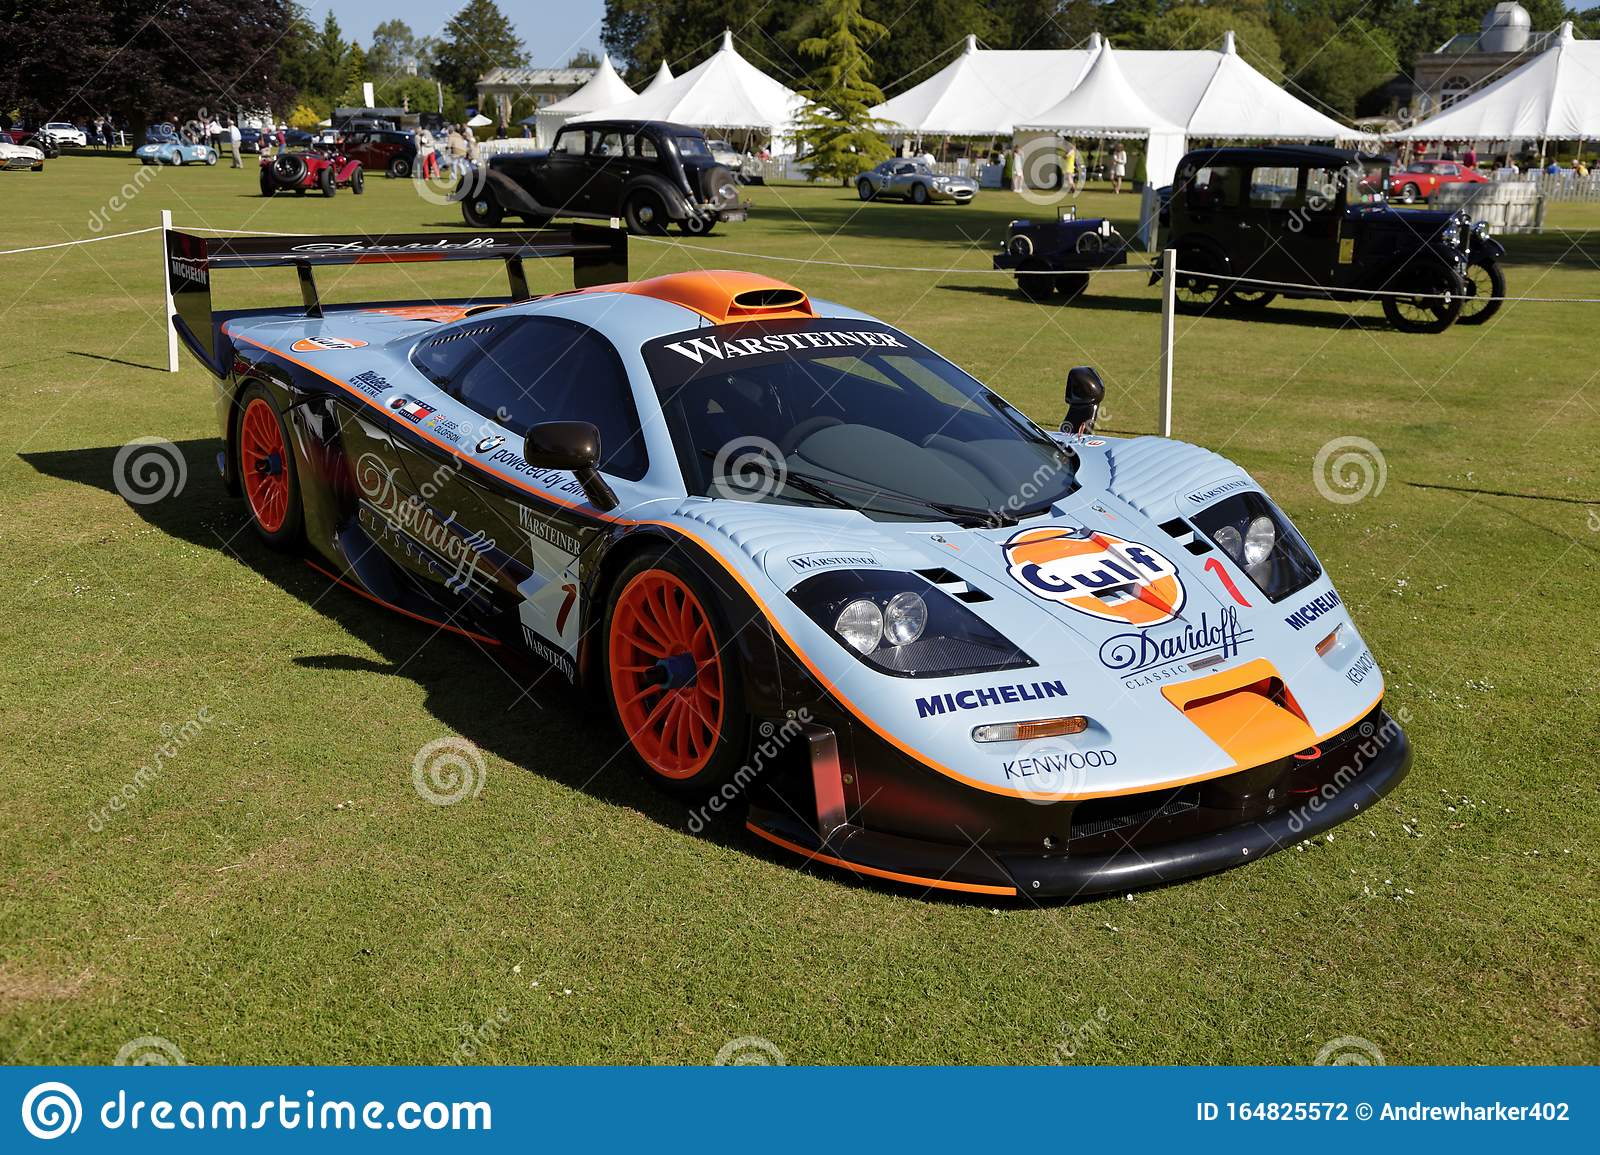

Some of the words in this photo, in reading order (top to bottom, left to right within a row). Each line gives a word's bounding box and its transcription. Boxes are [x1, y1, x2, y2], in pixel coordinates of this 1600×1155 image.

[172, 260, 207, 285] MICHELIN
[663, 331, 908, 365] WARSTEINER
[349, 377, 380, 399] MAGAZINE
[488, 449, 554, 479] powered
[542, 470, 567, 489] by
[519, 503, 581, 556] WARSTEINER
[791, 556, 878, 569] WARSTEINER
[1020, 546, 1164, 593] Gulf
[1204, 557, 1253, 608] 1
[555, 583, 577, 638] 1
[1284, 589, 1342, 631] MICHELIN
[522, 624, 574, 686] WARSTEINER
[1098, 605, 1255, 676] Davidoff
[1125, 665, 1188, 690] CLASSIC
[915, 680, 1069, 719] MICHELIN
[1003, 750, 1117, 780] KENWOOD
